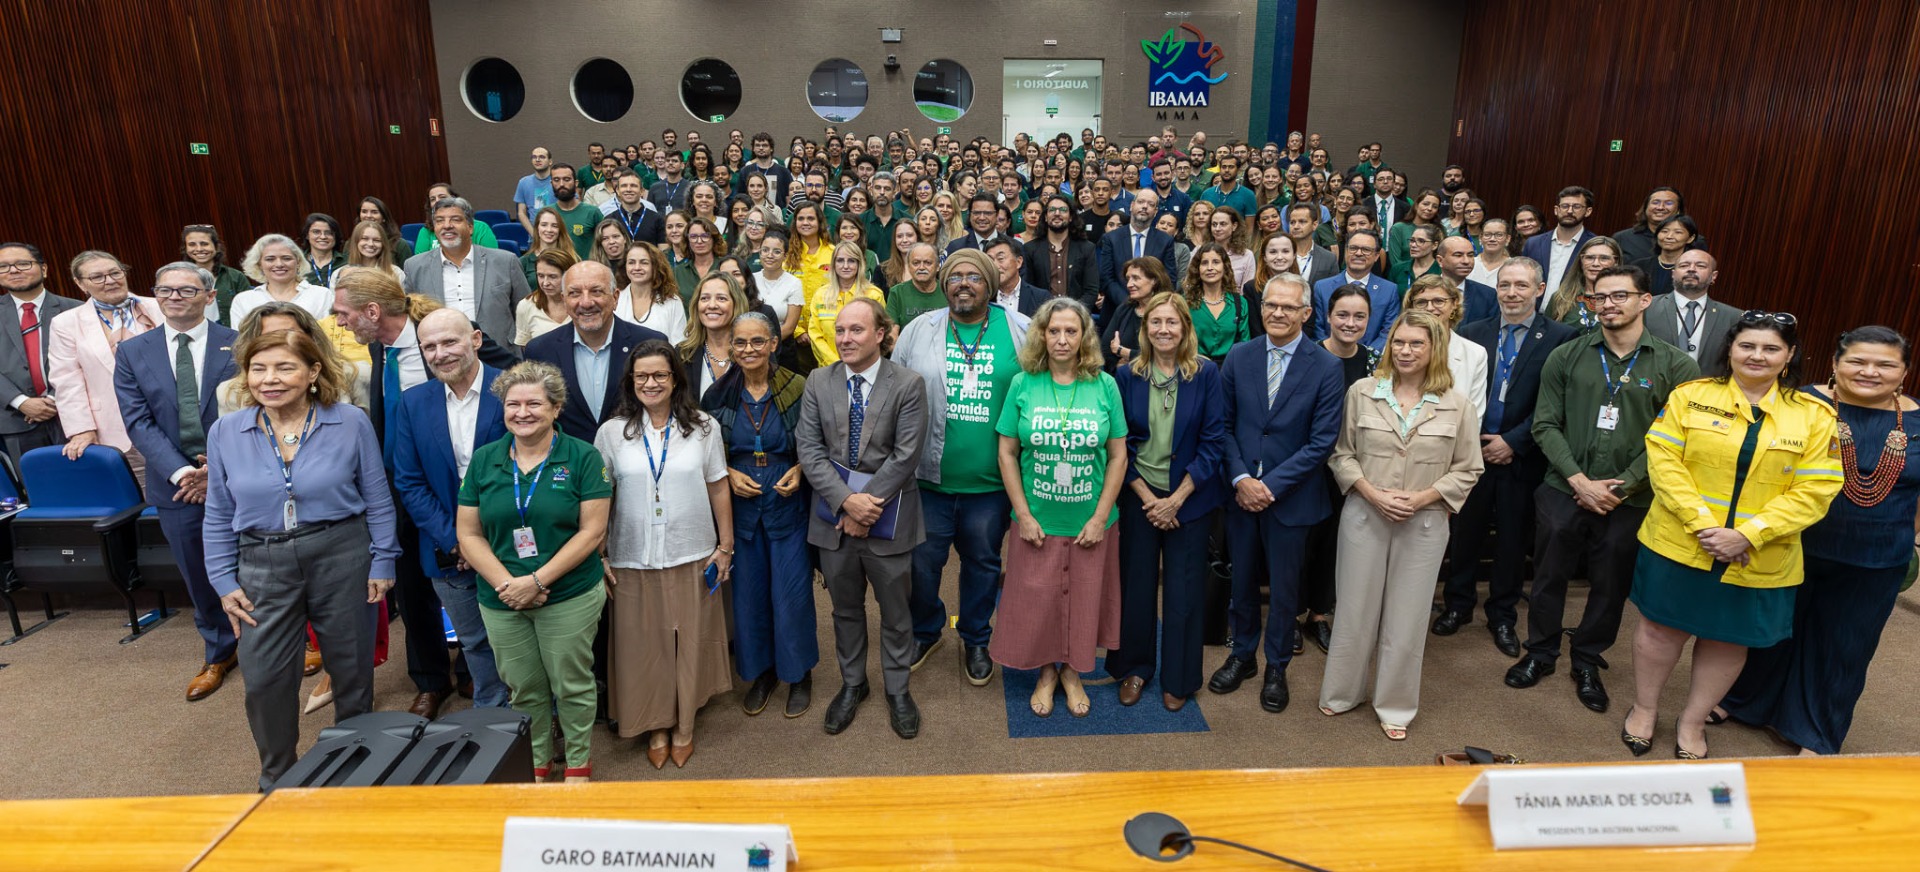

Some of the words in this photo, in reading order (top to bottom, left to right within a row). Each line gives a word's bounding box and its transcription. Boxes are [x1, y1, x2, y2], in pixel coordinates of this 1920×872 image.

[1149, 91, 1208, 107] IBAMA
[960, 413, 990, 423] veneno
[1070, 430, 1099, 450] pé
[1780, 438, 1803, 448] IBAMA
[1033, 450, 1061, 463] água
[1034, 462, 1050, 476] ar
[1032, 488, 1052, 502] sem
[1054, 493, 1093, 503] veneno
[1515, 791, 1562, 809] TÂNIA
[1565, 794, 1614, 808] MARIA
[1618, 793, 1638, 807] DE
[1641, 791, 1694, 807] SOUZA
[541, 848, 595, 866] GARO
[602, 850, 716, 869] BATMANIAN
